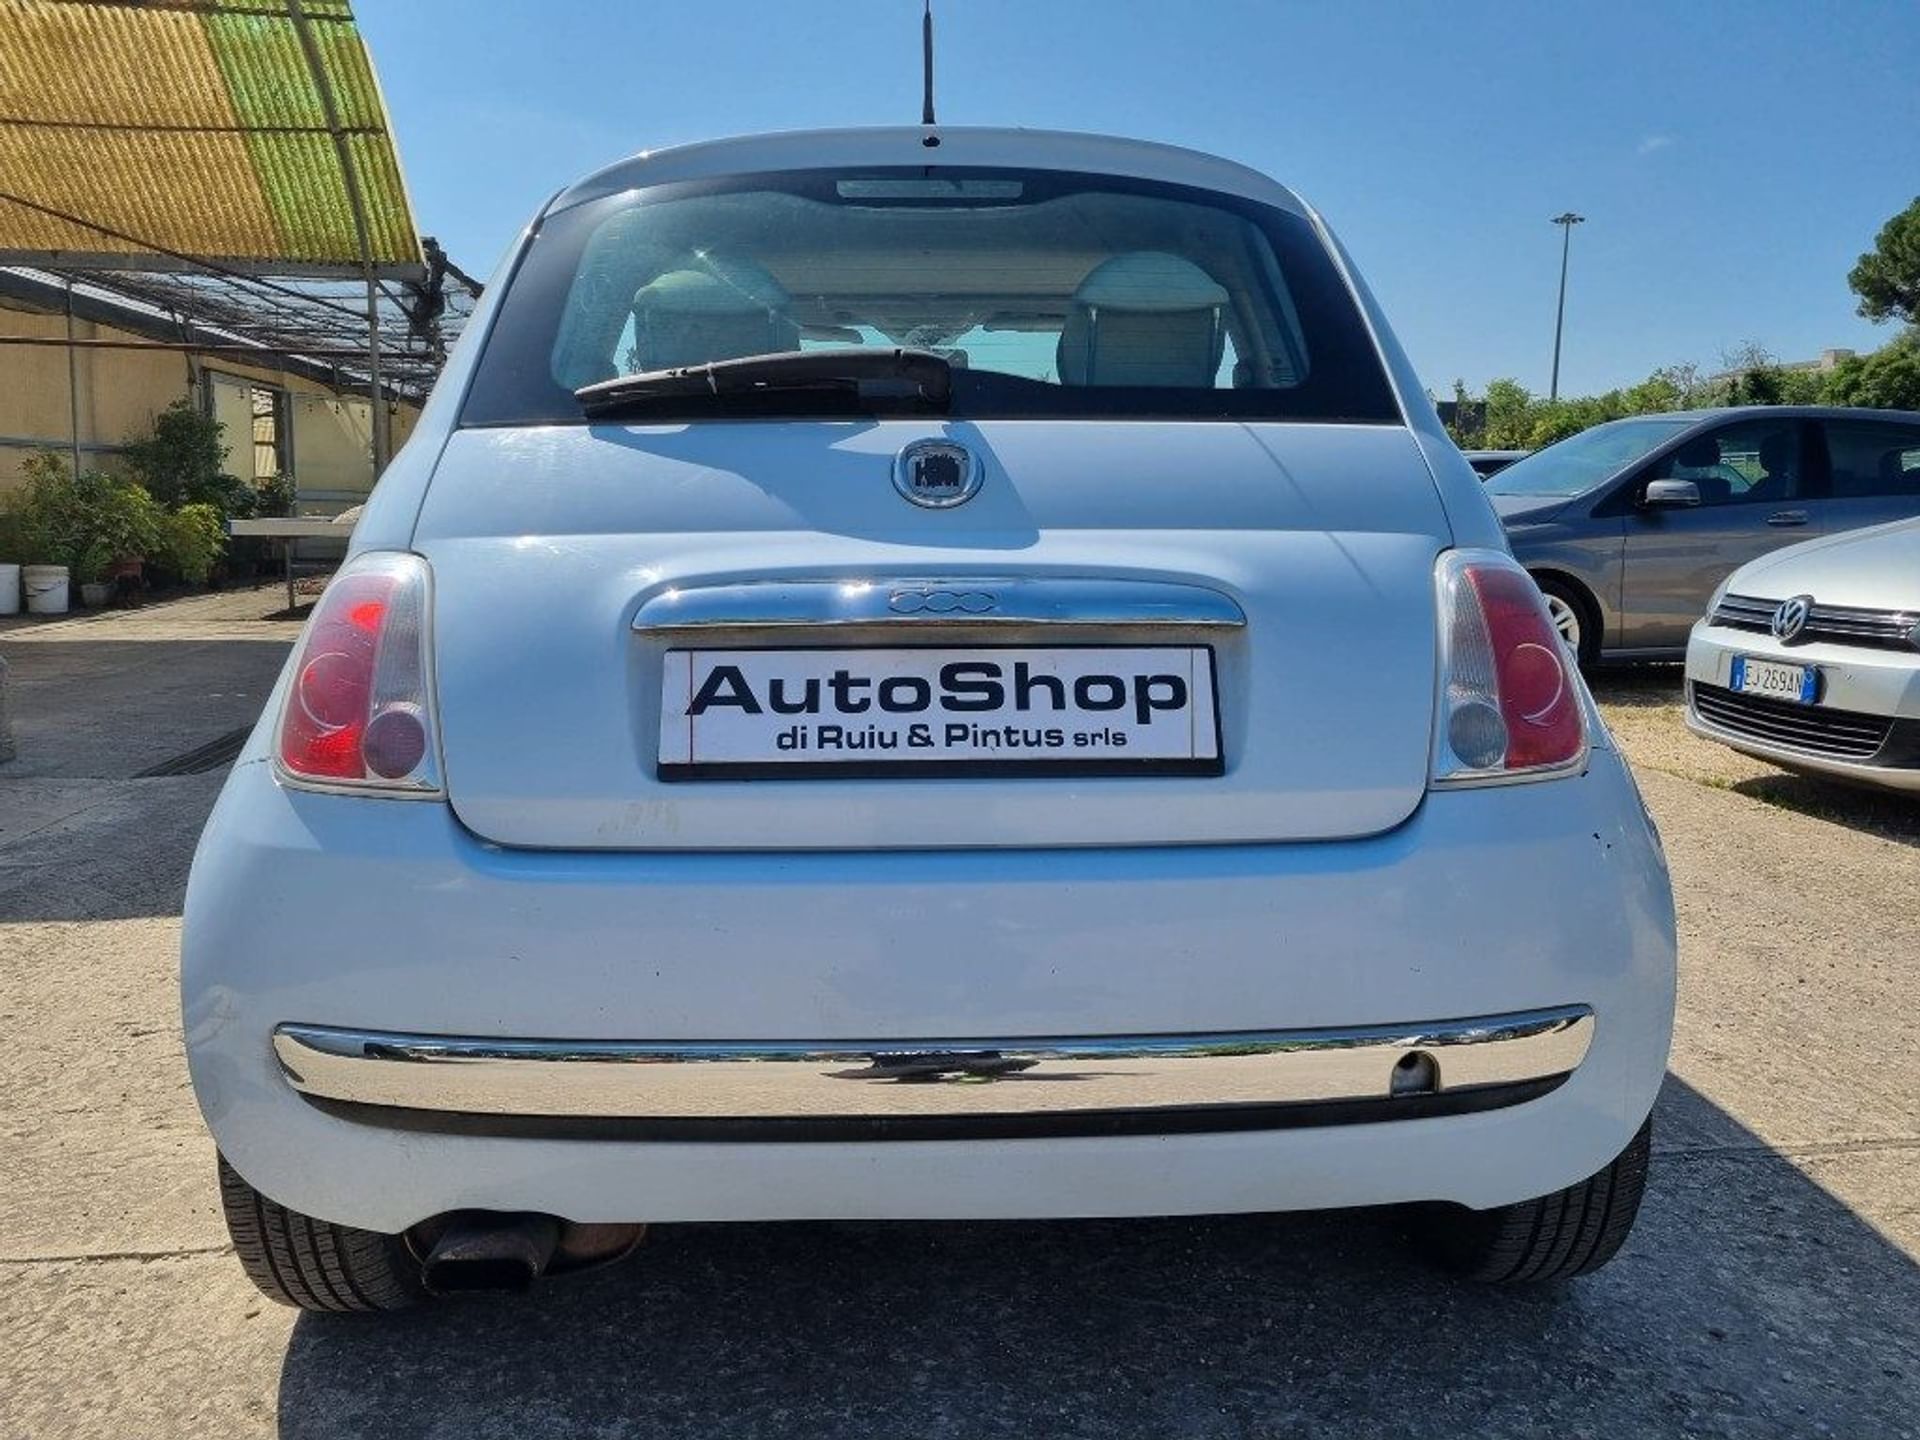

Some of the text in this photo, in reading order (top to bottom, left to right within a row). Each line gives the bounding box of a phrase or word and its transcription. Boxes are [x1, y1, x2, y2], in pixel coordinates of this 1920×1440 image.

[685, 662, 1187, 724] AutoShop
[777, 724, 1127, 750] di Ruiu & Pintus srls
